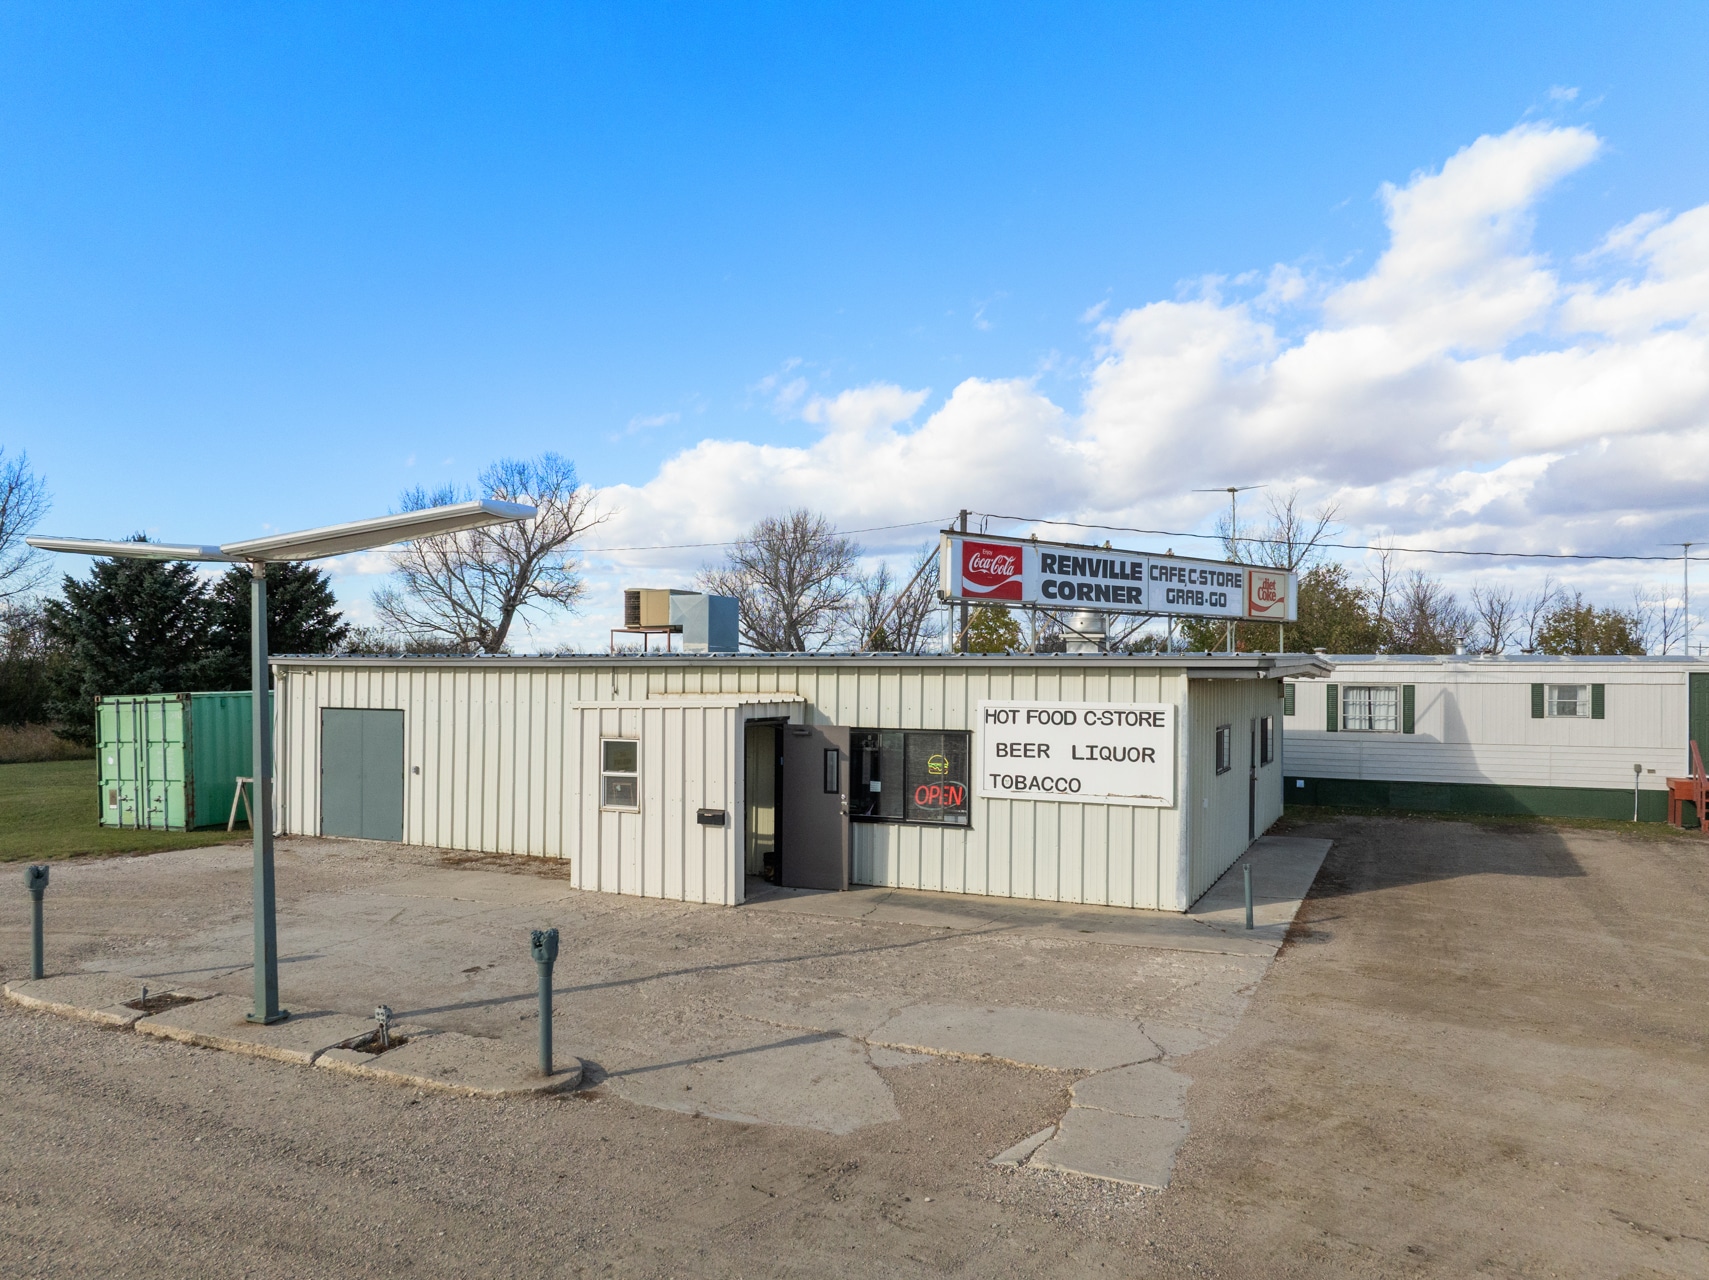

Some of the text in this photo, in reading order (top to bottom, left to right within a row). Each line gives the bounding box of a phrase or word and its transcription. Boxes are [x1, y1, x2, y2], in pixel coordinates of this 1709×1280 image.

[969, 552, 1016, 576] Coca-Cola
[1041, 553, 1142, 581] RENVILLE
[1041, 579, 1142, 605] CORNER
[1257, 586, 1276, 602] Coke
[1262, 577, 1276, 590] diet
[985, 708, 1165, 728] HOT FOOD C-STORE
[996, 742, 1156, 764] BEER LIQUOR
[989, 773, 1082, 793] TOBACCO
[914, 785, 963, 806] OPEN
